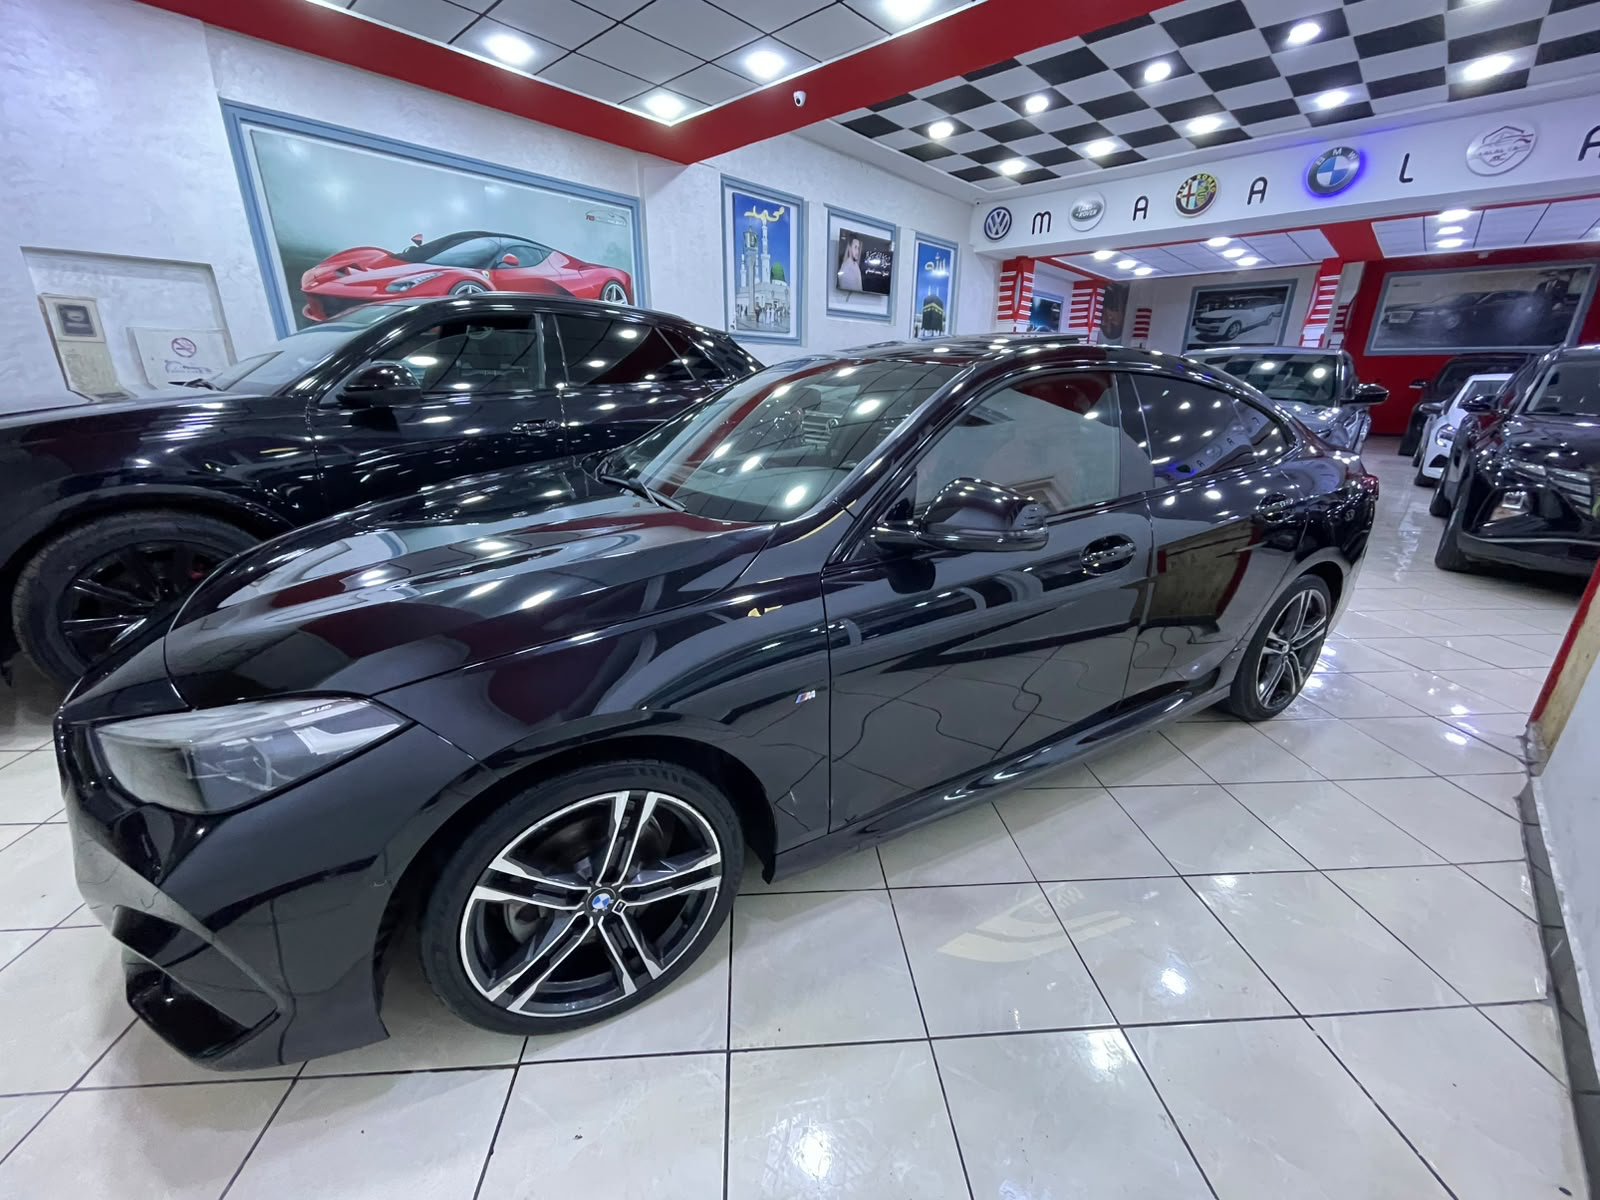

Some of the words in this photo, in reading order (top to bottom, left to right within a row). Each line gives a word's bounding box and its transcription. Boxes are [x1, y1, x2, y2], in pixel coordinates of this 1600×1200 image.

[1315, 147, 1358, 166] BMW
[1133, 195, 1149, 221] A
[1247, 176, 1268, 205] A
[1399, 153, 1413, 183] L
[744, 205, 785, 221] محمد
